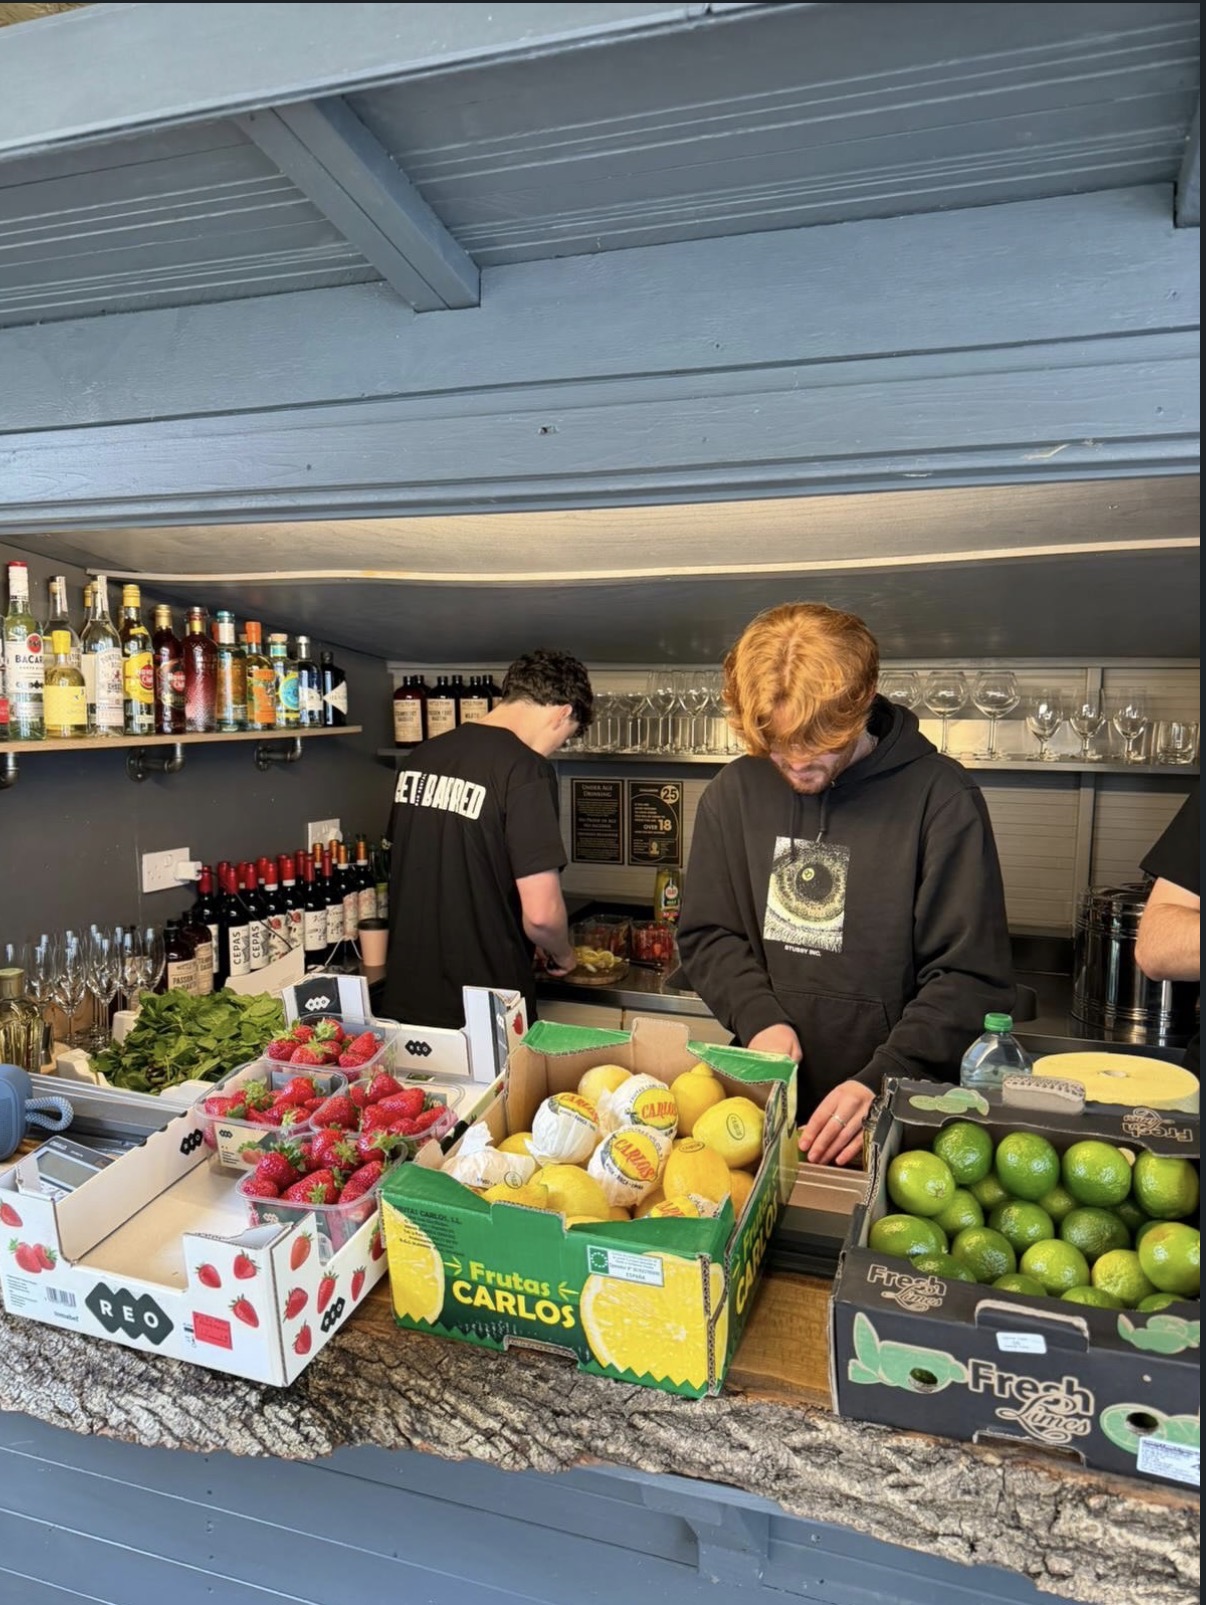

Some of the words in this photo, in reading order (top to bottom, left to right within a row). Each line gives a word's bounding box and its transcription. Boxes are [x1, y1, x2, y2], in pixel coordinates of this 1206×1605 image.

[662, 788, 678, 800] 25
[658, 819, 672, 831] 18
[232, 931, 242, 965] CEPAS
[252, 925, 261, 959] CEPAS
[642, 1101, 678, 1119] CARLOS
[1122, 1123, 1193, 1142] Fresh
[614, 1139, 655, 1179] CARLOS
[469, 1260, 550, 1297] Frutas
[867, 1264, 947, 1296] Fresh
[100, 1299, 159, 1329] REO
[452, 1280, 576, 1328] CARLOS
[881, 1284, 943, 1312] Limes
[967, 1358, 1095, 1416] Fresh
[995, 1391, 1091, 1444] Limes
